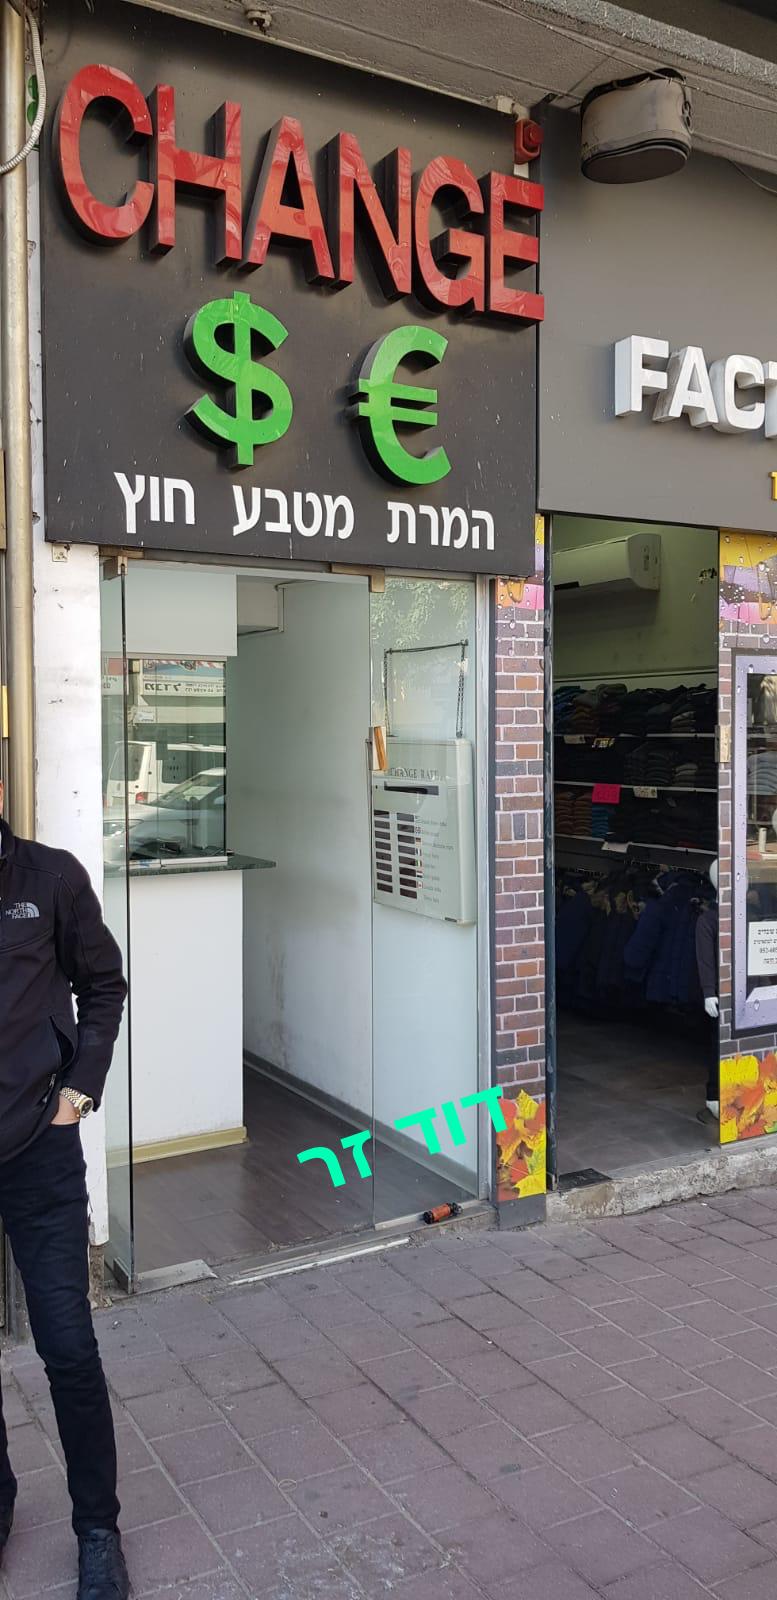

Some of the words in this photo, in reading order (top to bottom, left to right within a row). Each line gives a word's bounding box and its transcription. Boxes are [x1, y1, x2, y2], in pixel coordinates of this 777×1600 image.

[56, 64, 546, 325] CHANGE
[615, 335, 777, 439] FAC
[113, 471, 196, 534] חוץ
[231, 484, 355, 540] מטבע
[386, 500, 495, 551] המרת
